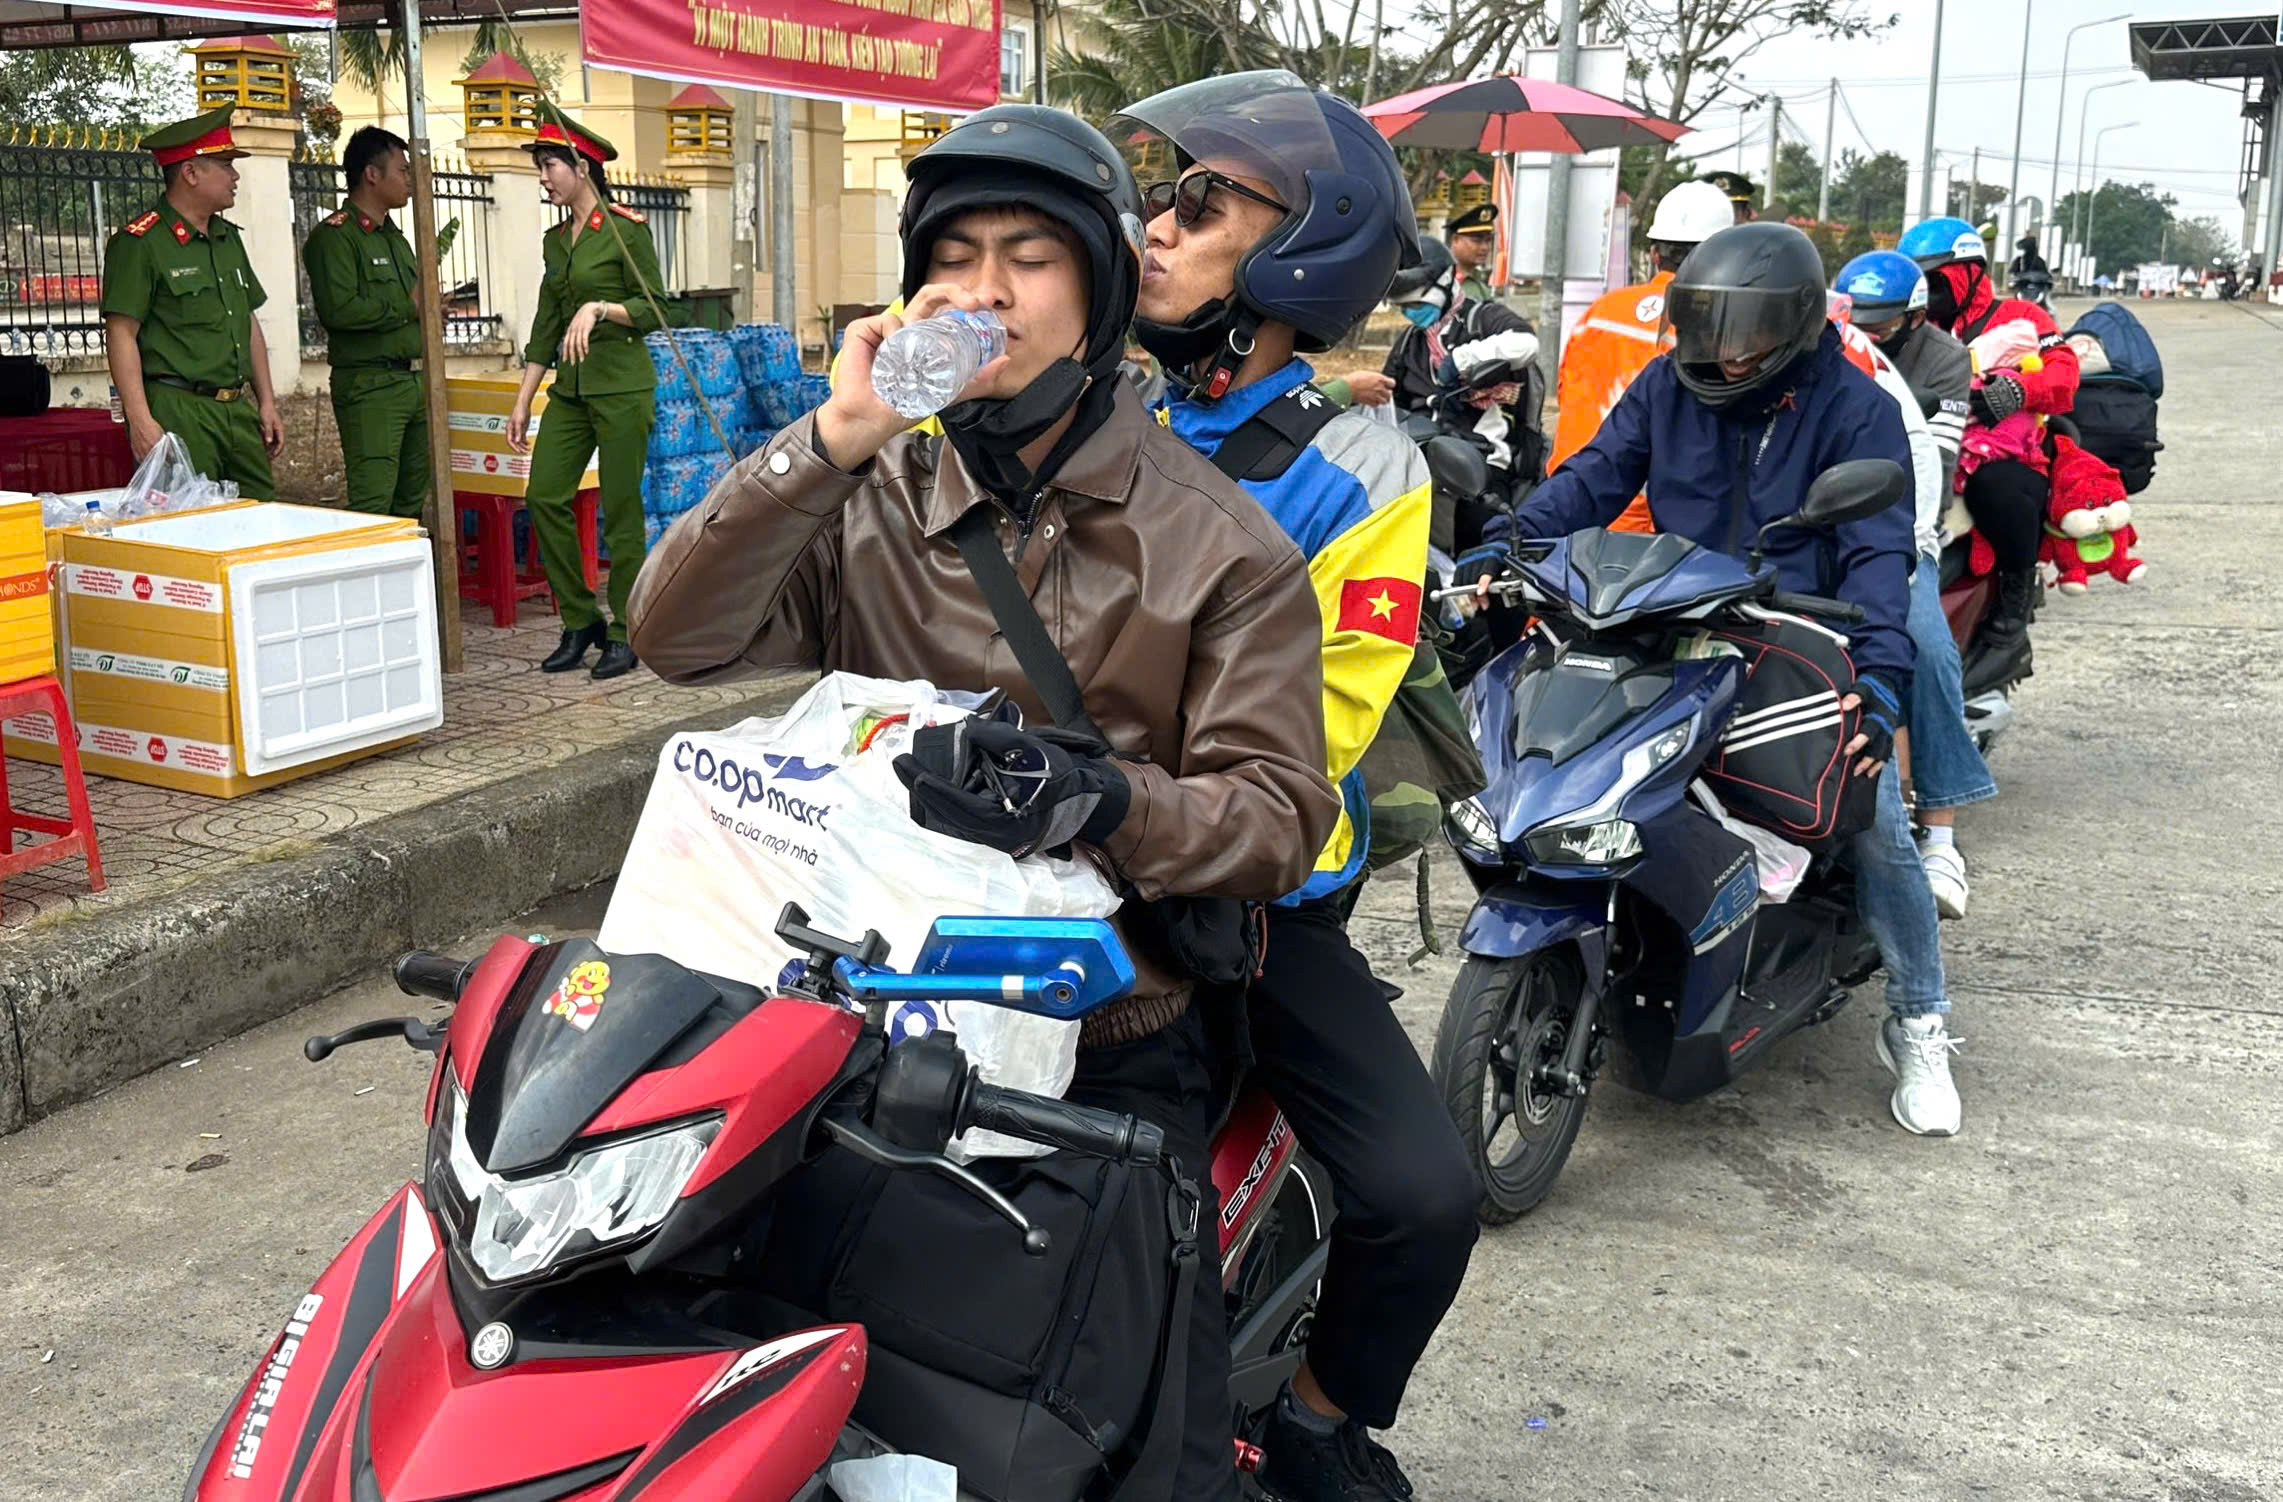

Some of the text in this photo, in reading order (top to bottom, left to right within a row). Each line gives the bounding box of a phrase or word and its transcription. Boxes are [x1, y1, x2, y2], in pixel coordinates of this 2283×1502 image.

[708, 2, 736, 58] MỘT
[737, 6, 769, 56] HÀNH
[771, 12, 803, 61] TRÌNH
[804, 25, 820, 64] AN
[821, 21, 849, 72] TOÀN,
[852, 24, 874, 72] KIẾN
[875, 37, 893, 81] TẠO
[893, 38, 923, 79] TƯƠNG
[1563, 658, 1612, 671] HONDA
[711, 805, 818, 866] bạn của mọi nhà
[1713, 850, 1750, 887] HONDA
